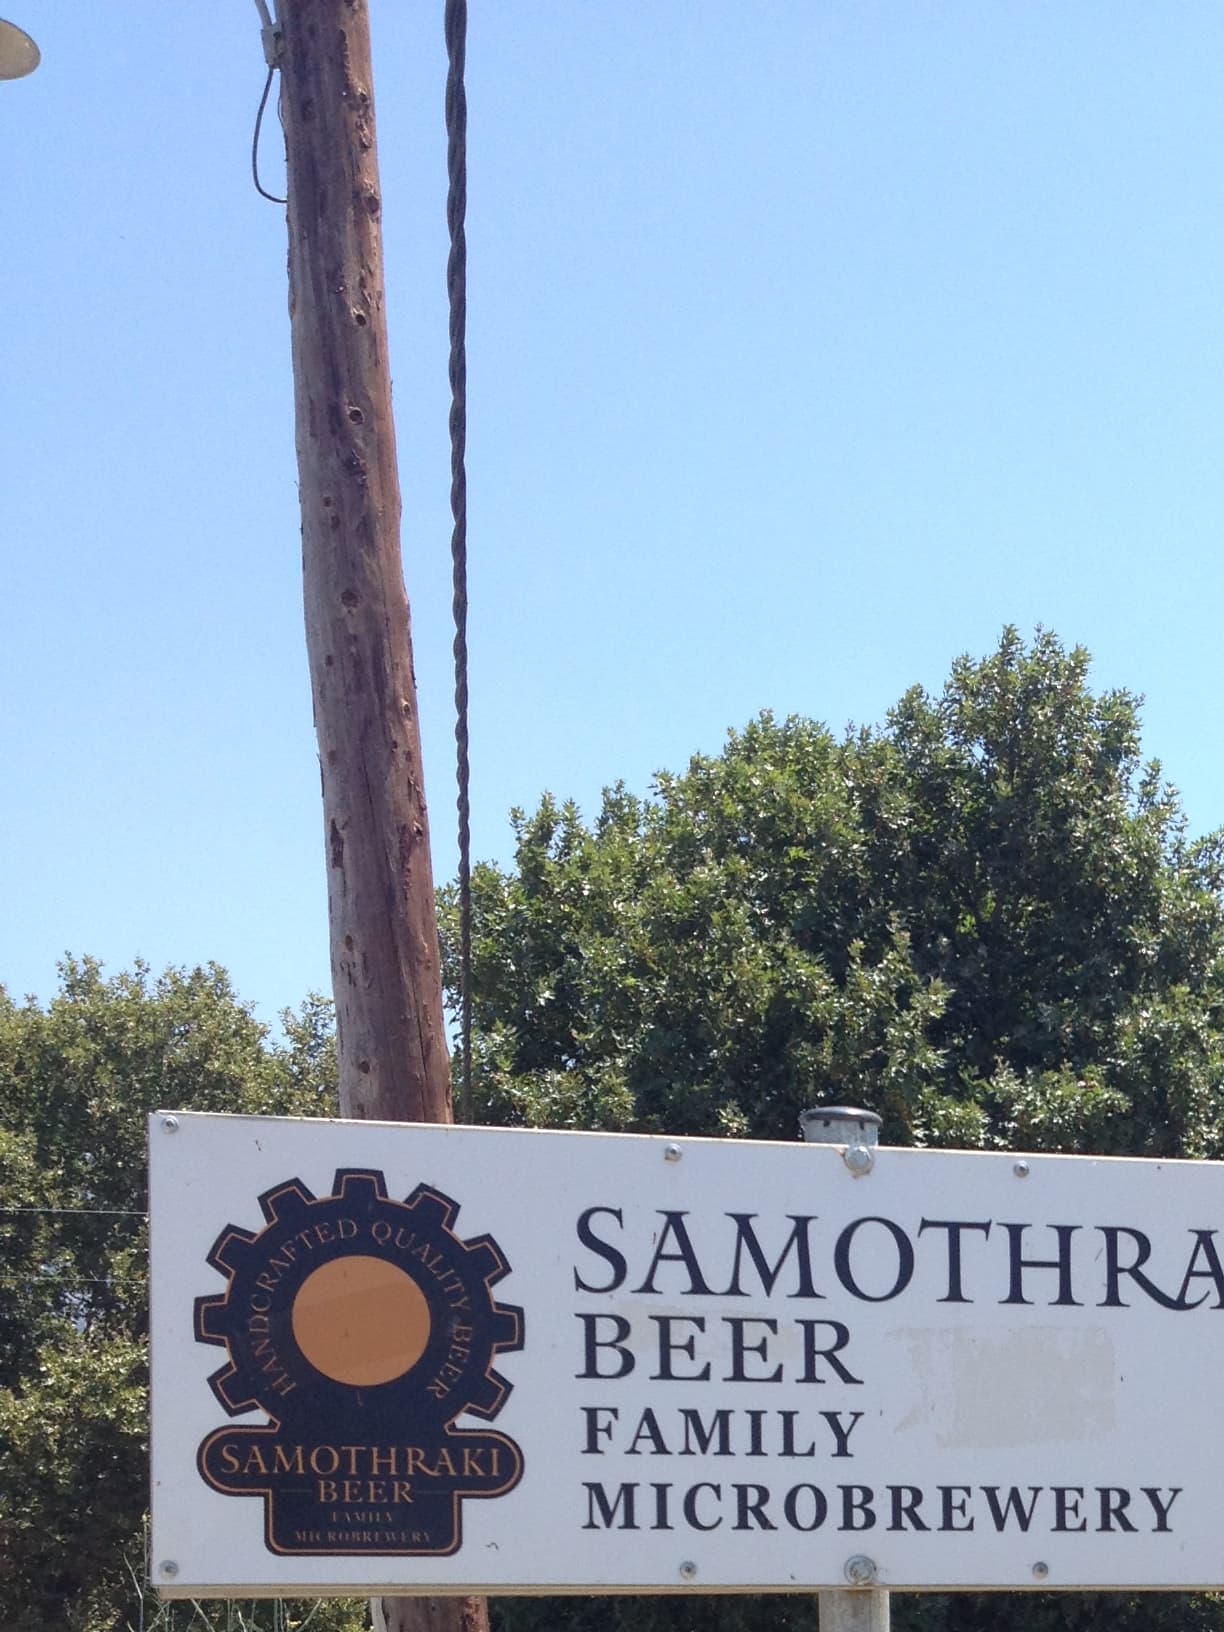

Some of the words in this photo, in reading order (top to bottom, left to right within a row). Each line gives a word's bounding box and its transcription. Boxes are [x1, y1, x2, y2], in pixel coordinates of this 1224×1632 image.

[248, 1217, 358, 1398] HANDCRAFTED
[371, 1220, 472, 1312] QUALITY
[426, 1322, 473, 1400] BEER
[573, 1312, 865, 1386] BEER
[580, 1407, 866, 1459] FAMILY
[220, 1444, 501, 1479] SAMOTHRAKI
[316, 1480, 415, 1505] BEER
[581, 1481, 1185, 1533] MICROBREWERY
[295, 1531, 433, 1544] MICROBREWERY
[331, 1511, 394, 1524] FAMILY
